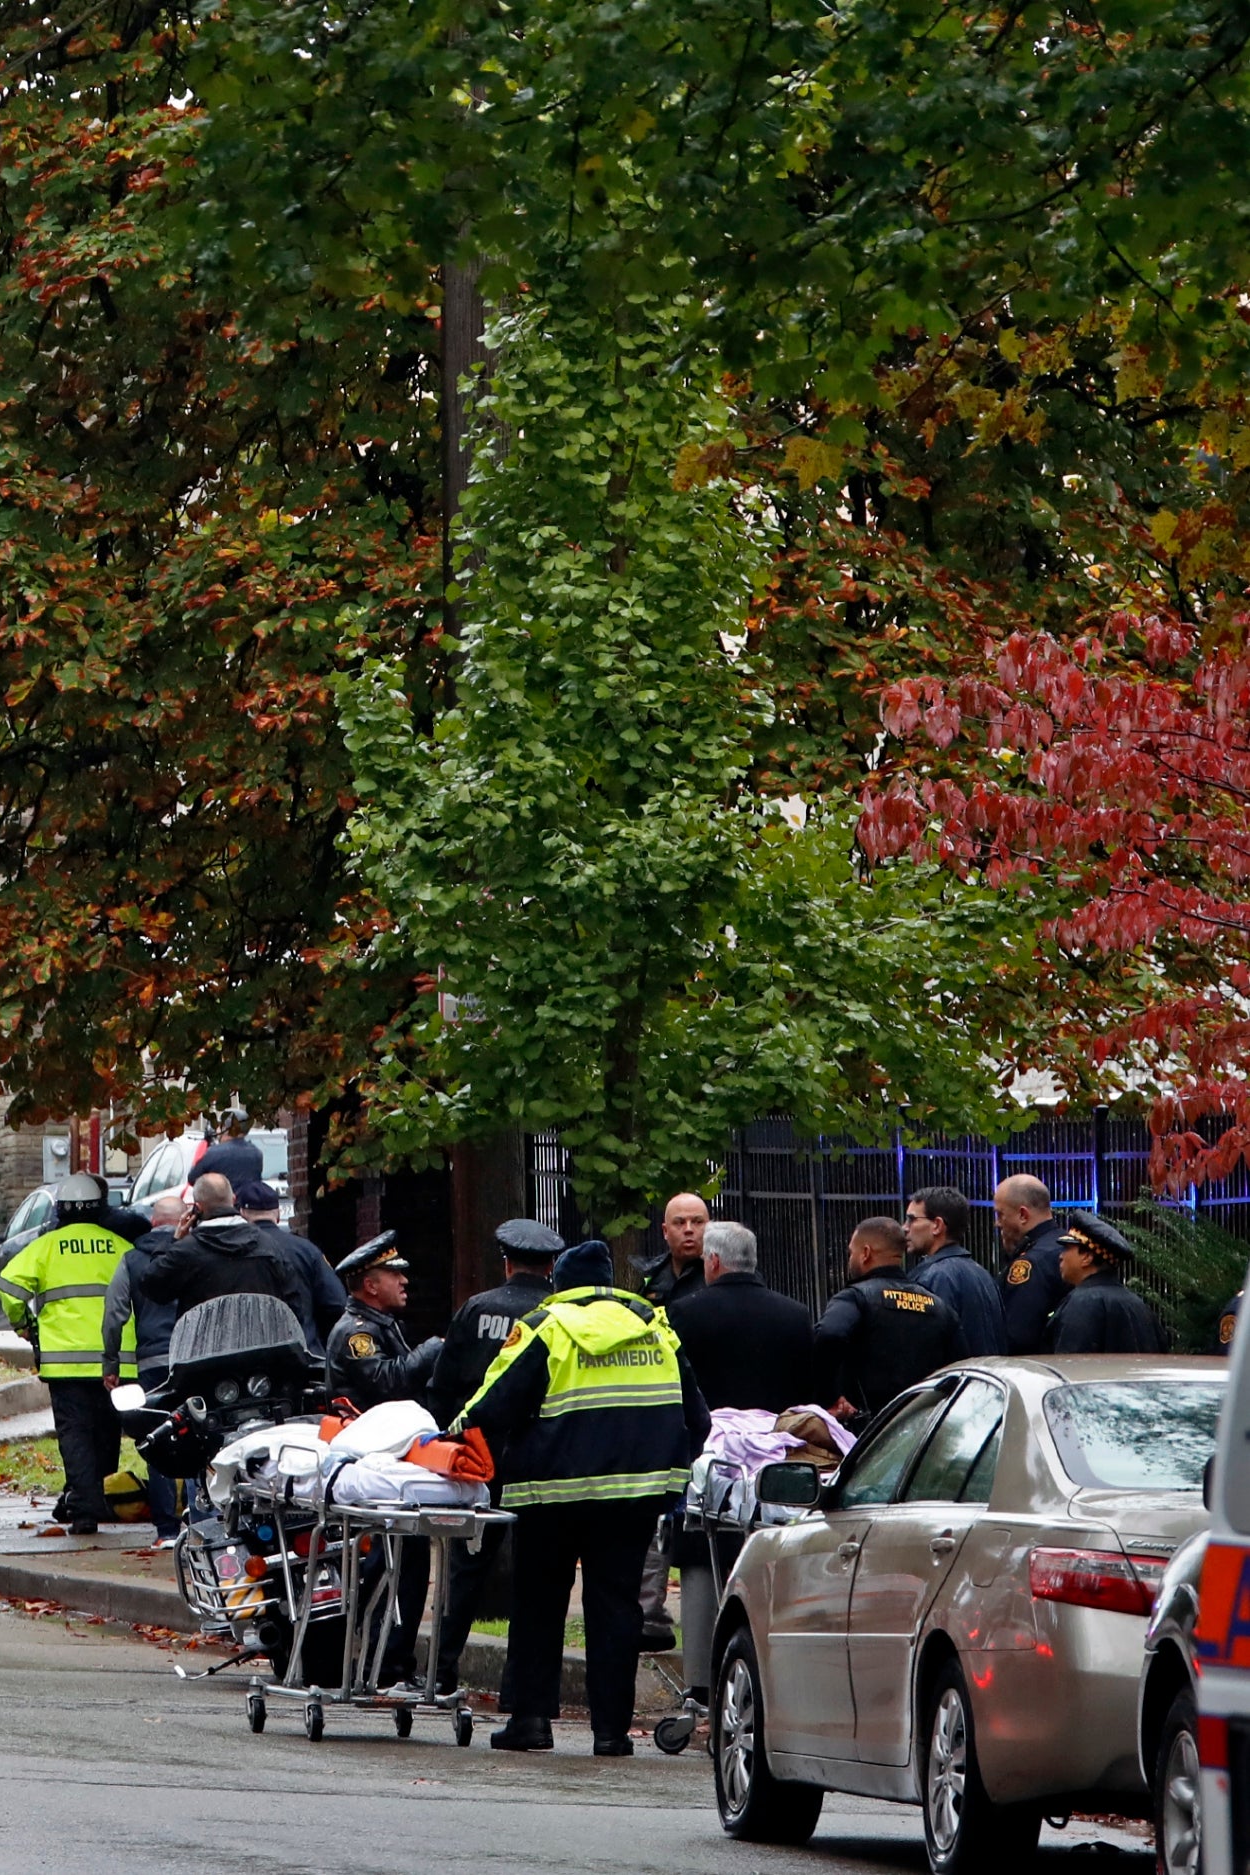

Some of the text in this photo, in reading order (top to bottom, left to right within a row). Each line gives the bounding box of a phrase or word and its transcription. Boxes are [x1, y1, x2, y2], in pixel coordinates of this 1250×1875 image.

[59, 1239, 116, 1255] POLICE
[883, 1289, 935, 1306] PITTSBURGH
[896, 1299, 926, 1312] POLICE
[478, 1314, 518, 1340] POL
[578, 1348, 664, 1369] PARAMEDIC
